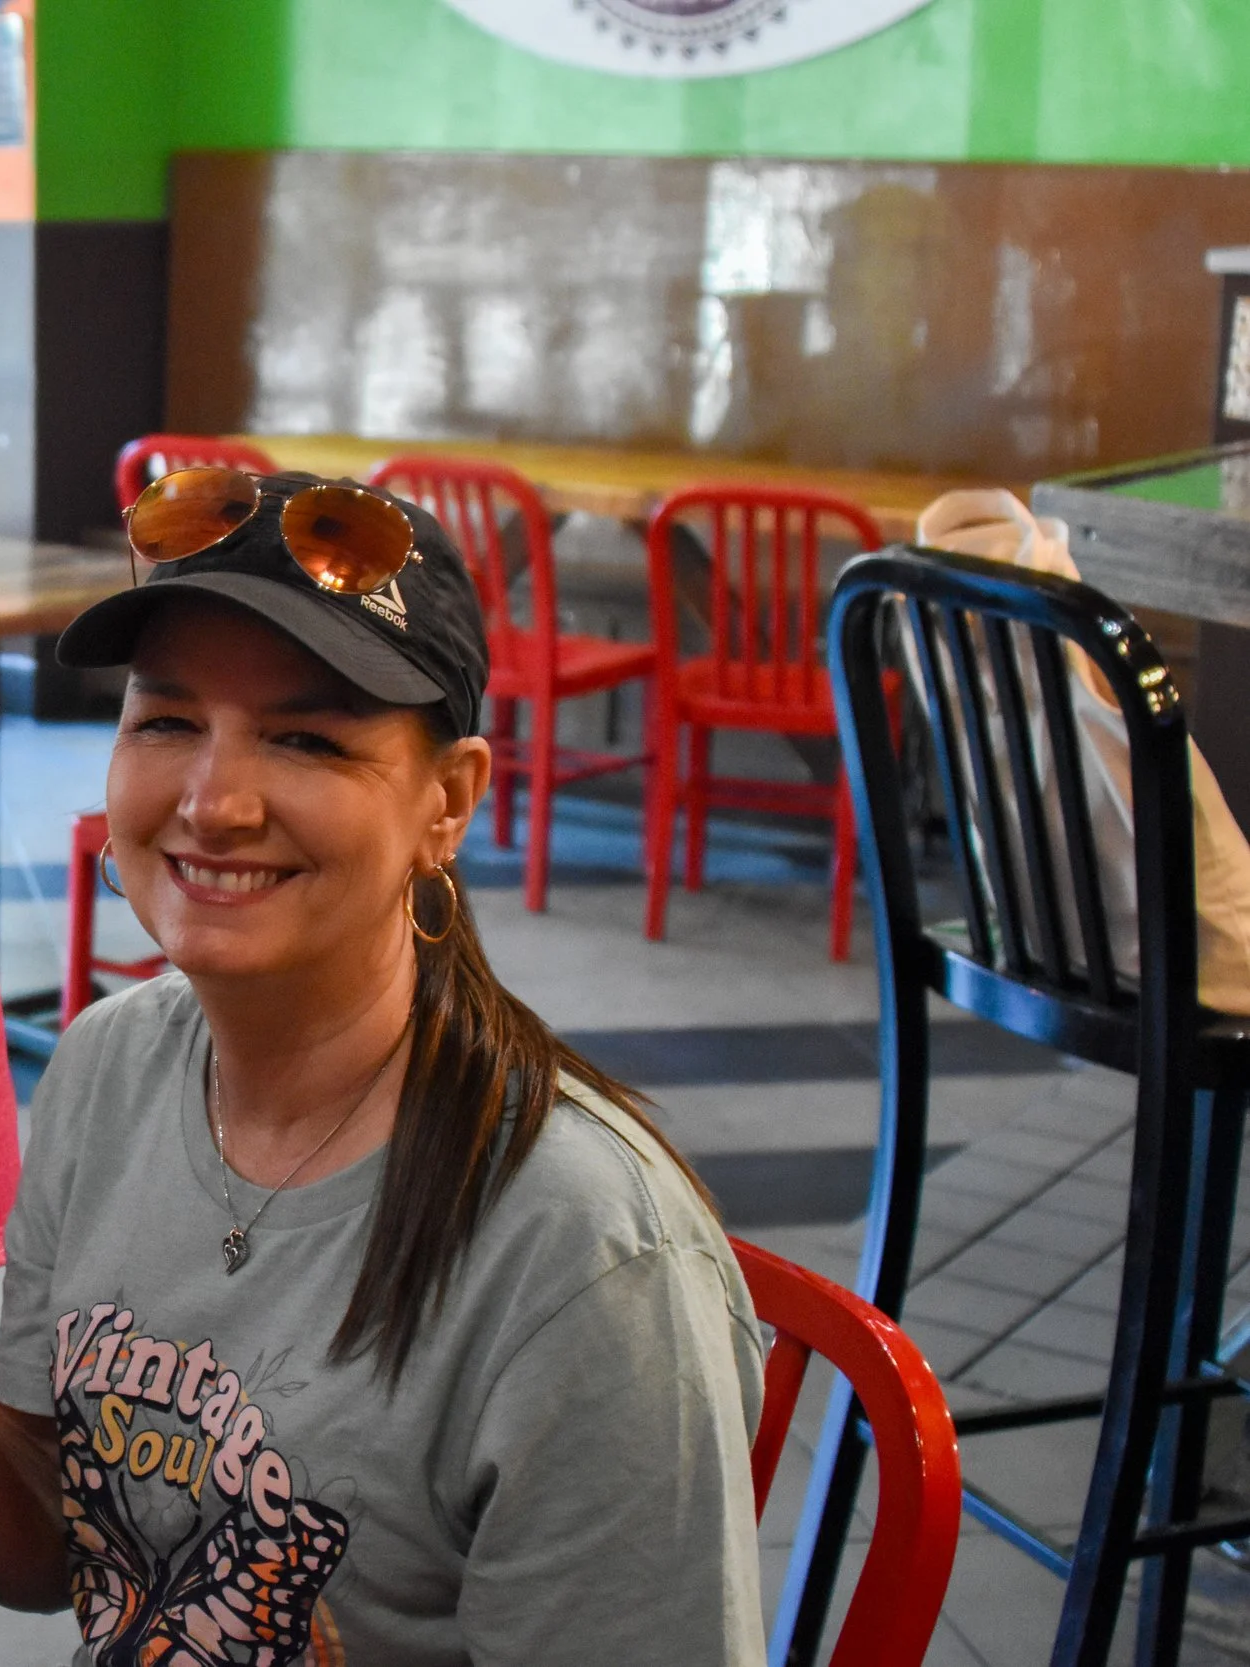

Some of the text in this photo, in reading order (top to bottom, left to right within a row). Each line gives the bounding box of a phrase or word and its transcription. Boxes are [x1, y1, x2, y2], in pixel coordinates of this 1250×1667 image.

[360, 594, 408, 632] Reebok
[53, 1302, 293, 1532] Vintage
[92, 1393, 217, 1503] Soul
